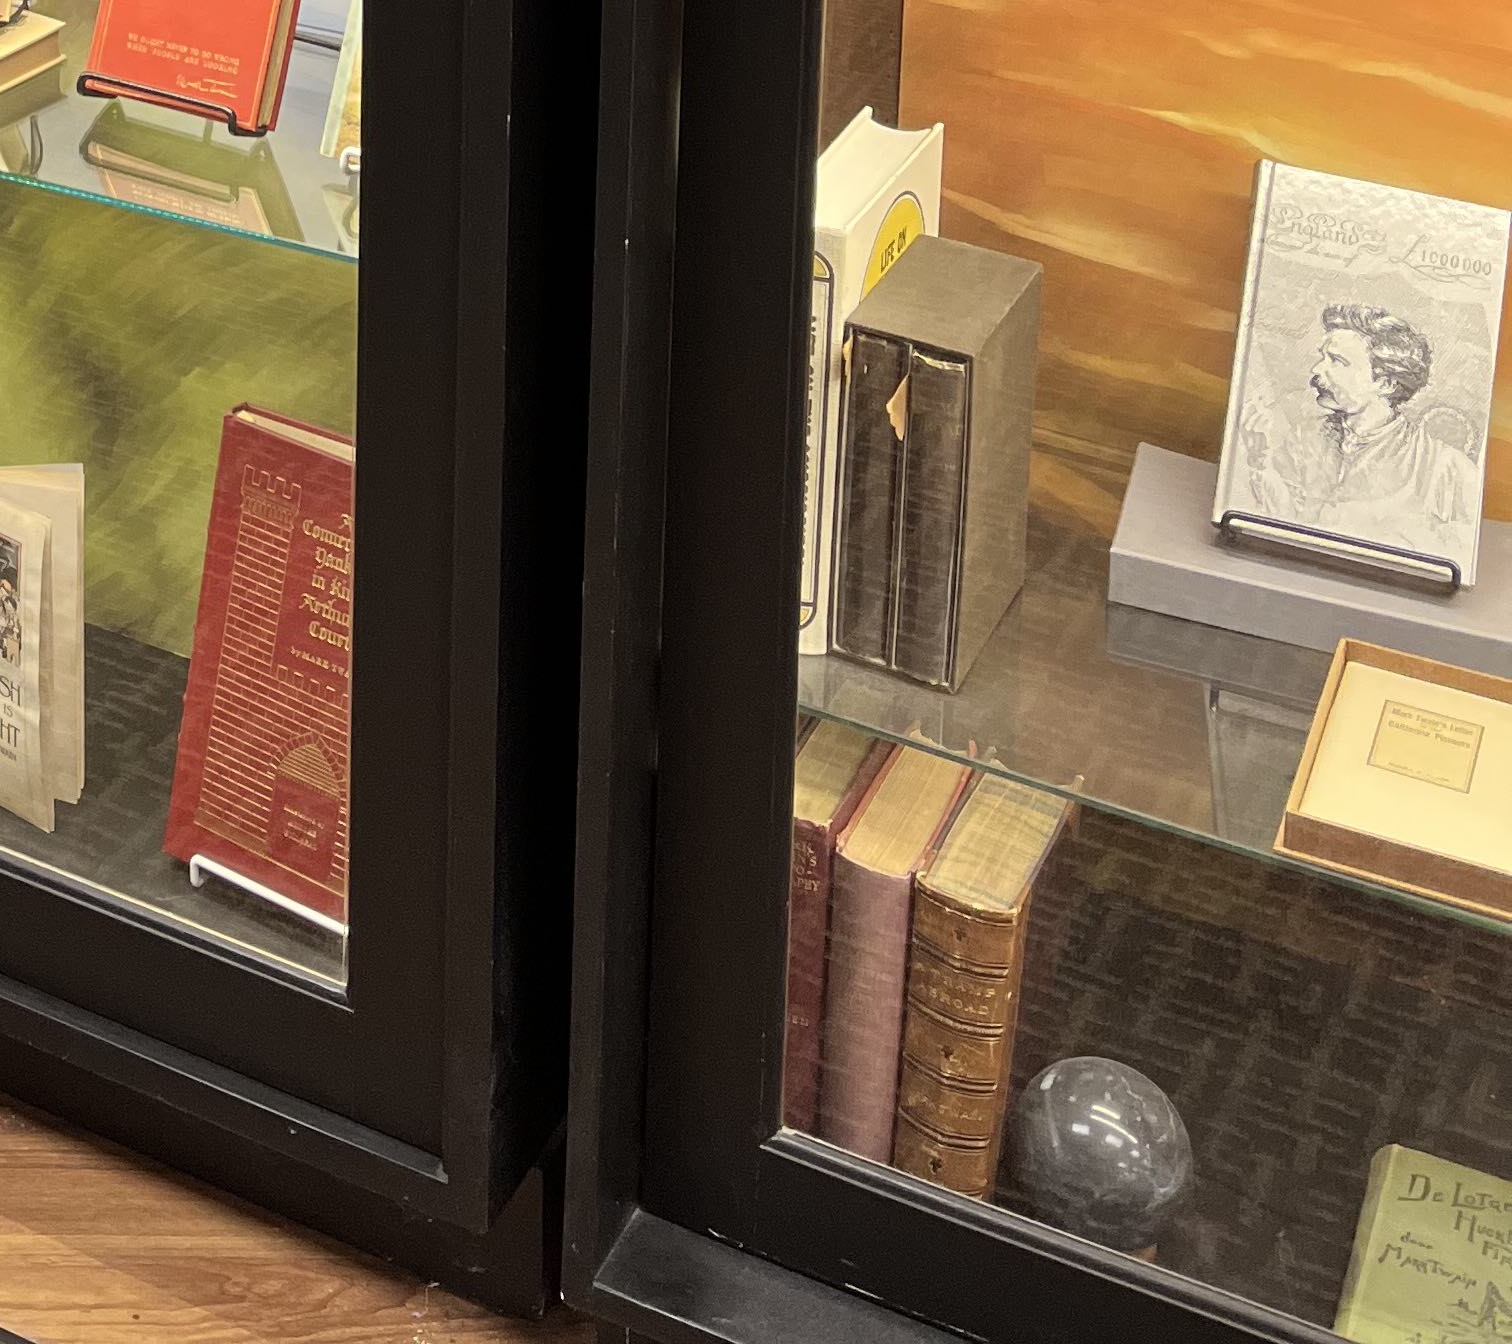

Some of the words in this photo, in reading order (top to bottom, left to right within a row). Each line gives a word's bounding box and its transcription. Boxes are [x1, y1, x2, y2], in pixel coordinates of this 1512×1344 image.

[880, 245, 897, 274] LIFE
[329, 575, 351, 603] Kin
[298, 591, 350, 628] Arthu
[301, 650, 330, 671] MARK
[3, 702, 14, 718] IS
